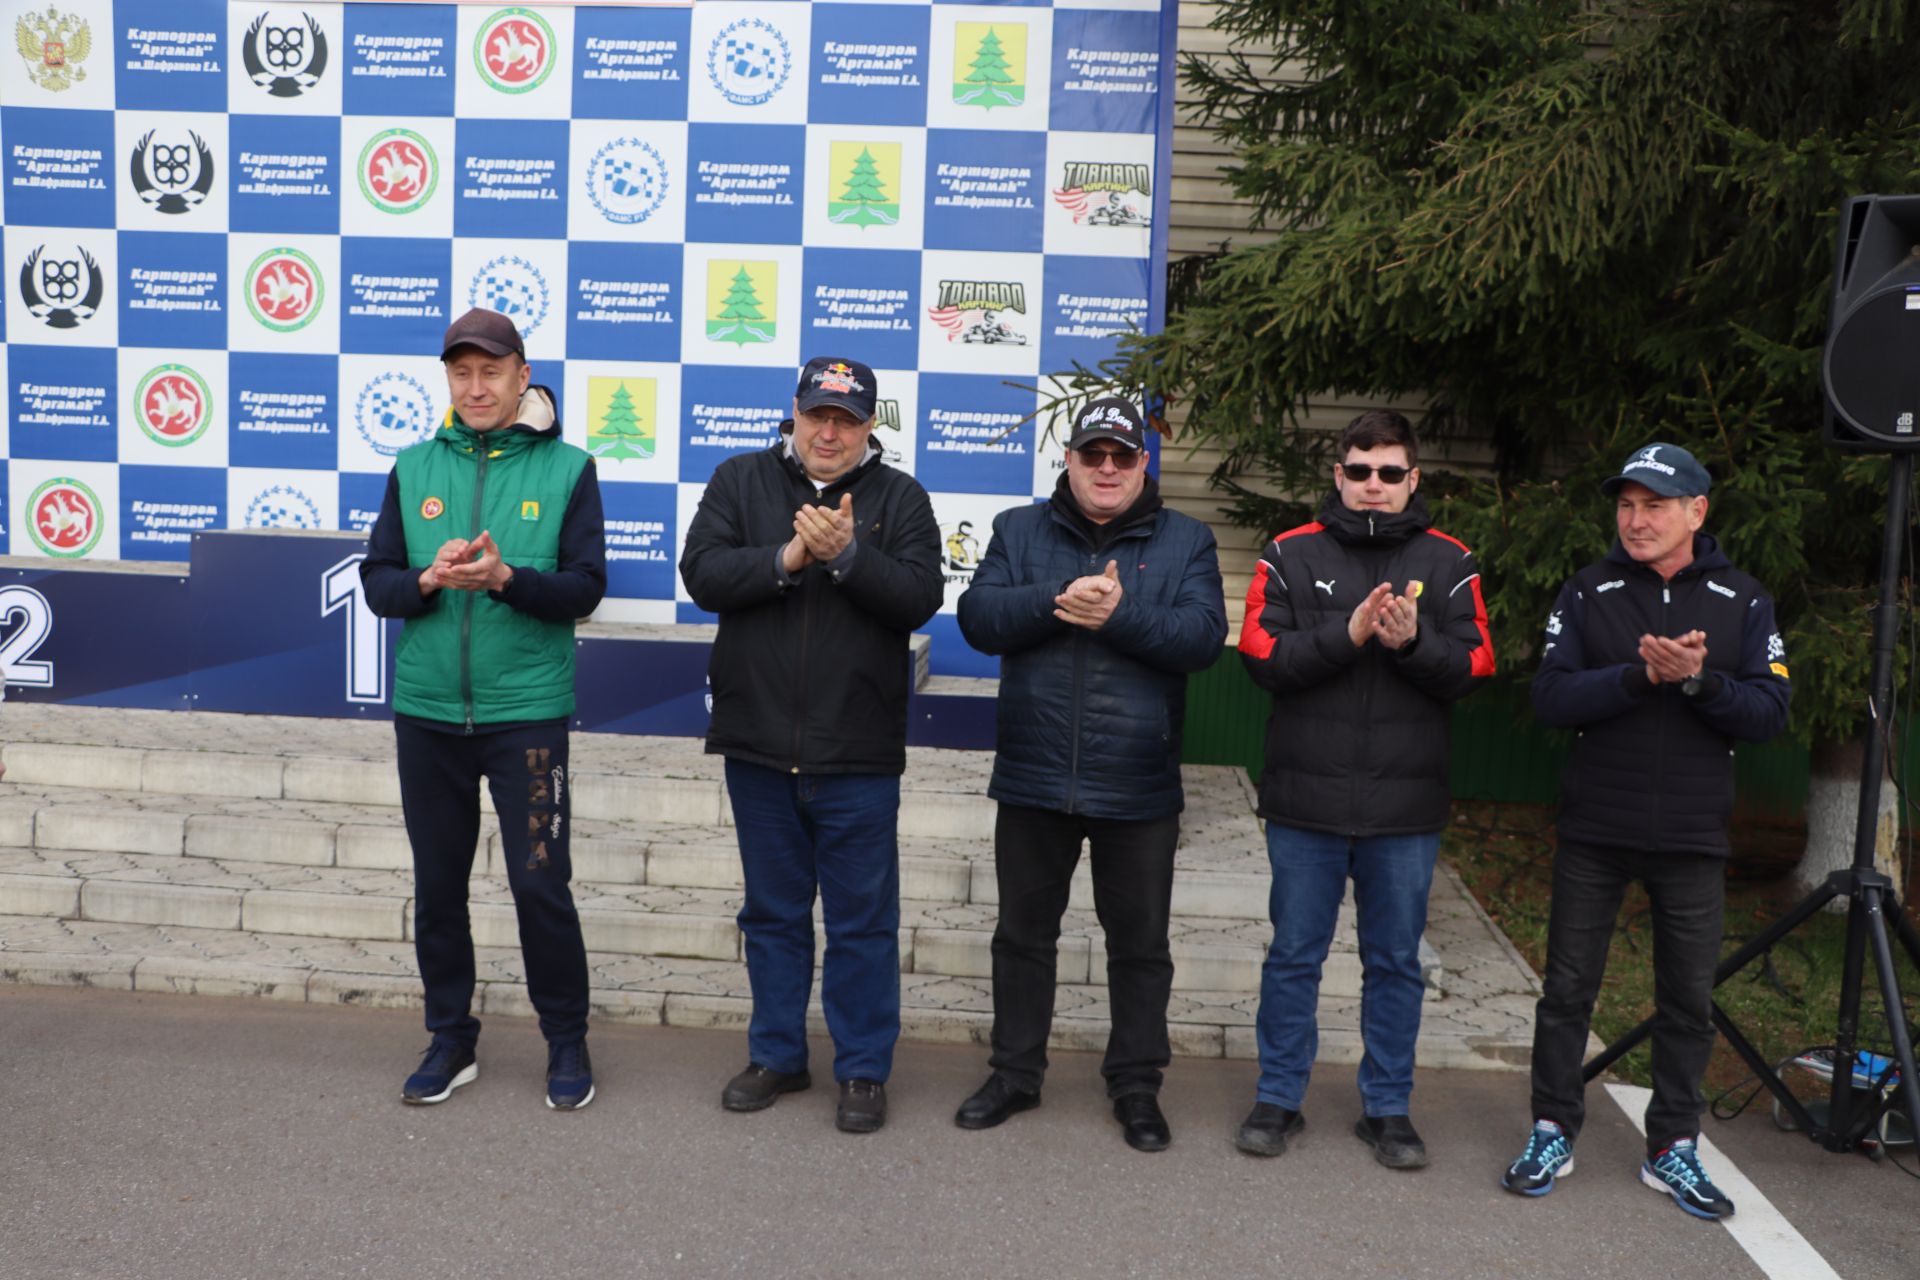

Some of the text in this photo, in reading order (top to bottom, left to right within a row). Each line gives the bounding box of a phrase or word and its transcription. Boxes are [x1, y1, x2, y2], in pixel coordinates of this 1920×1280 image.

[127, 28, 217, 44] Картодром
[353, 34, 444, 50] Картодром
[585, 37, 678, 53] Картодром
[823, 41, 918, 58] Картодром
[13, 145, 102, 162] Картодром
[239, 152, 328, 168] Картодром
[465, 156, 555, 172] Картодром
[698, 160, 791, 177] Картодром
[936, 163, 1031, 180] Картодром
[1062, 161, 1151, 197] TORNADO
[130, 268, 218, 284] Картодром
[351, 274, 439, 290] Картодром
[578, 279, 670, 295] Картодром
[815, 285, 909, 302] Картодром
[938, 280, 1026, 315] TORNADO
[19, 383, 106, 399] Картодром
[239, 390, 327, 407] Картодром
[692, 404, 784, 421] Картодром
[928, 409, 1023, 426] Картодром
[1896, 412, 1914, 426] dB
[131, 500, 218, 517] Картодром
[603, 520, 665, 534] тодром
[0, 584, 54, 689] 2
